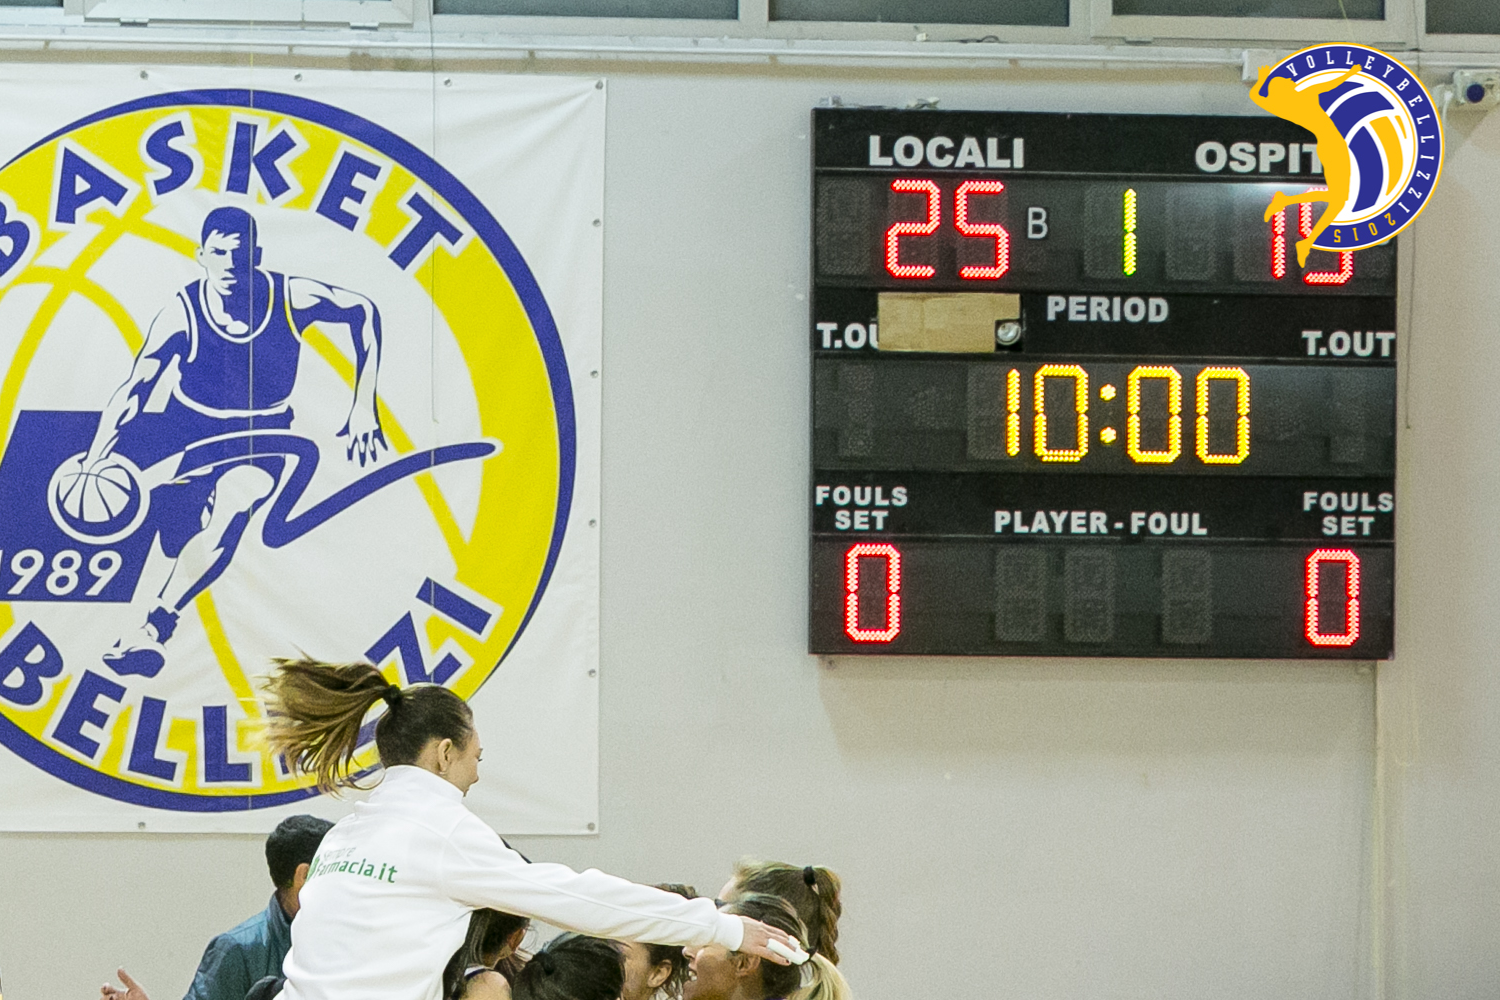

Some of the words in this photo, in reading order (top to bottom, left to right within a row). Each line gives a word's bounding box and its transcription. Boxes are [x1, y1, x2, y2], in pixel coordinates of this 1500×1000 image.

[869, 135, 1024, 171] LOCALI
[1195, 141, 1323, 174] OSPIT
[886, 180, 1010, 279] 25
[1123, 188, 1137, 276] 1
[1047, 296, 1168, 322] PERIOD
[1302, 332, 1394, 357] T.OUT
[1006, 364, 1250, 465] 10:00
[816, 485, 907, 506] FOULS
[1303, 493, 1393, 511] FOULS
[835, 510, 888, 530] SET
[1322, 515, 1375, 535] SET
[845, 543, 901, 642] 0
[1304, 549, 1360, 646] 0
